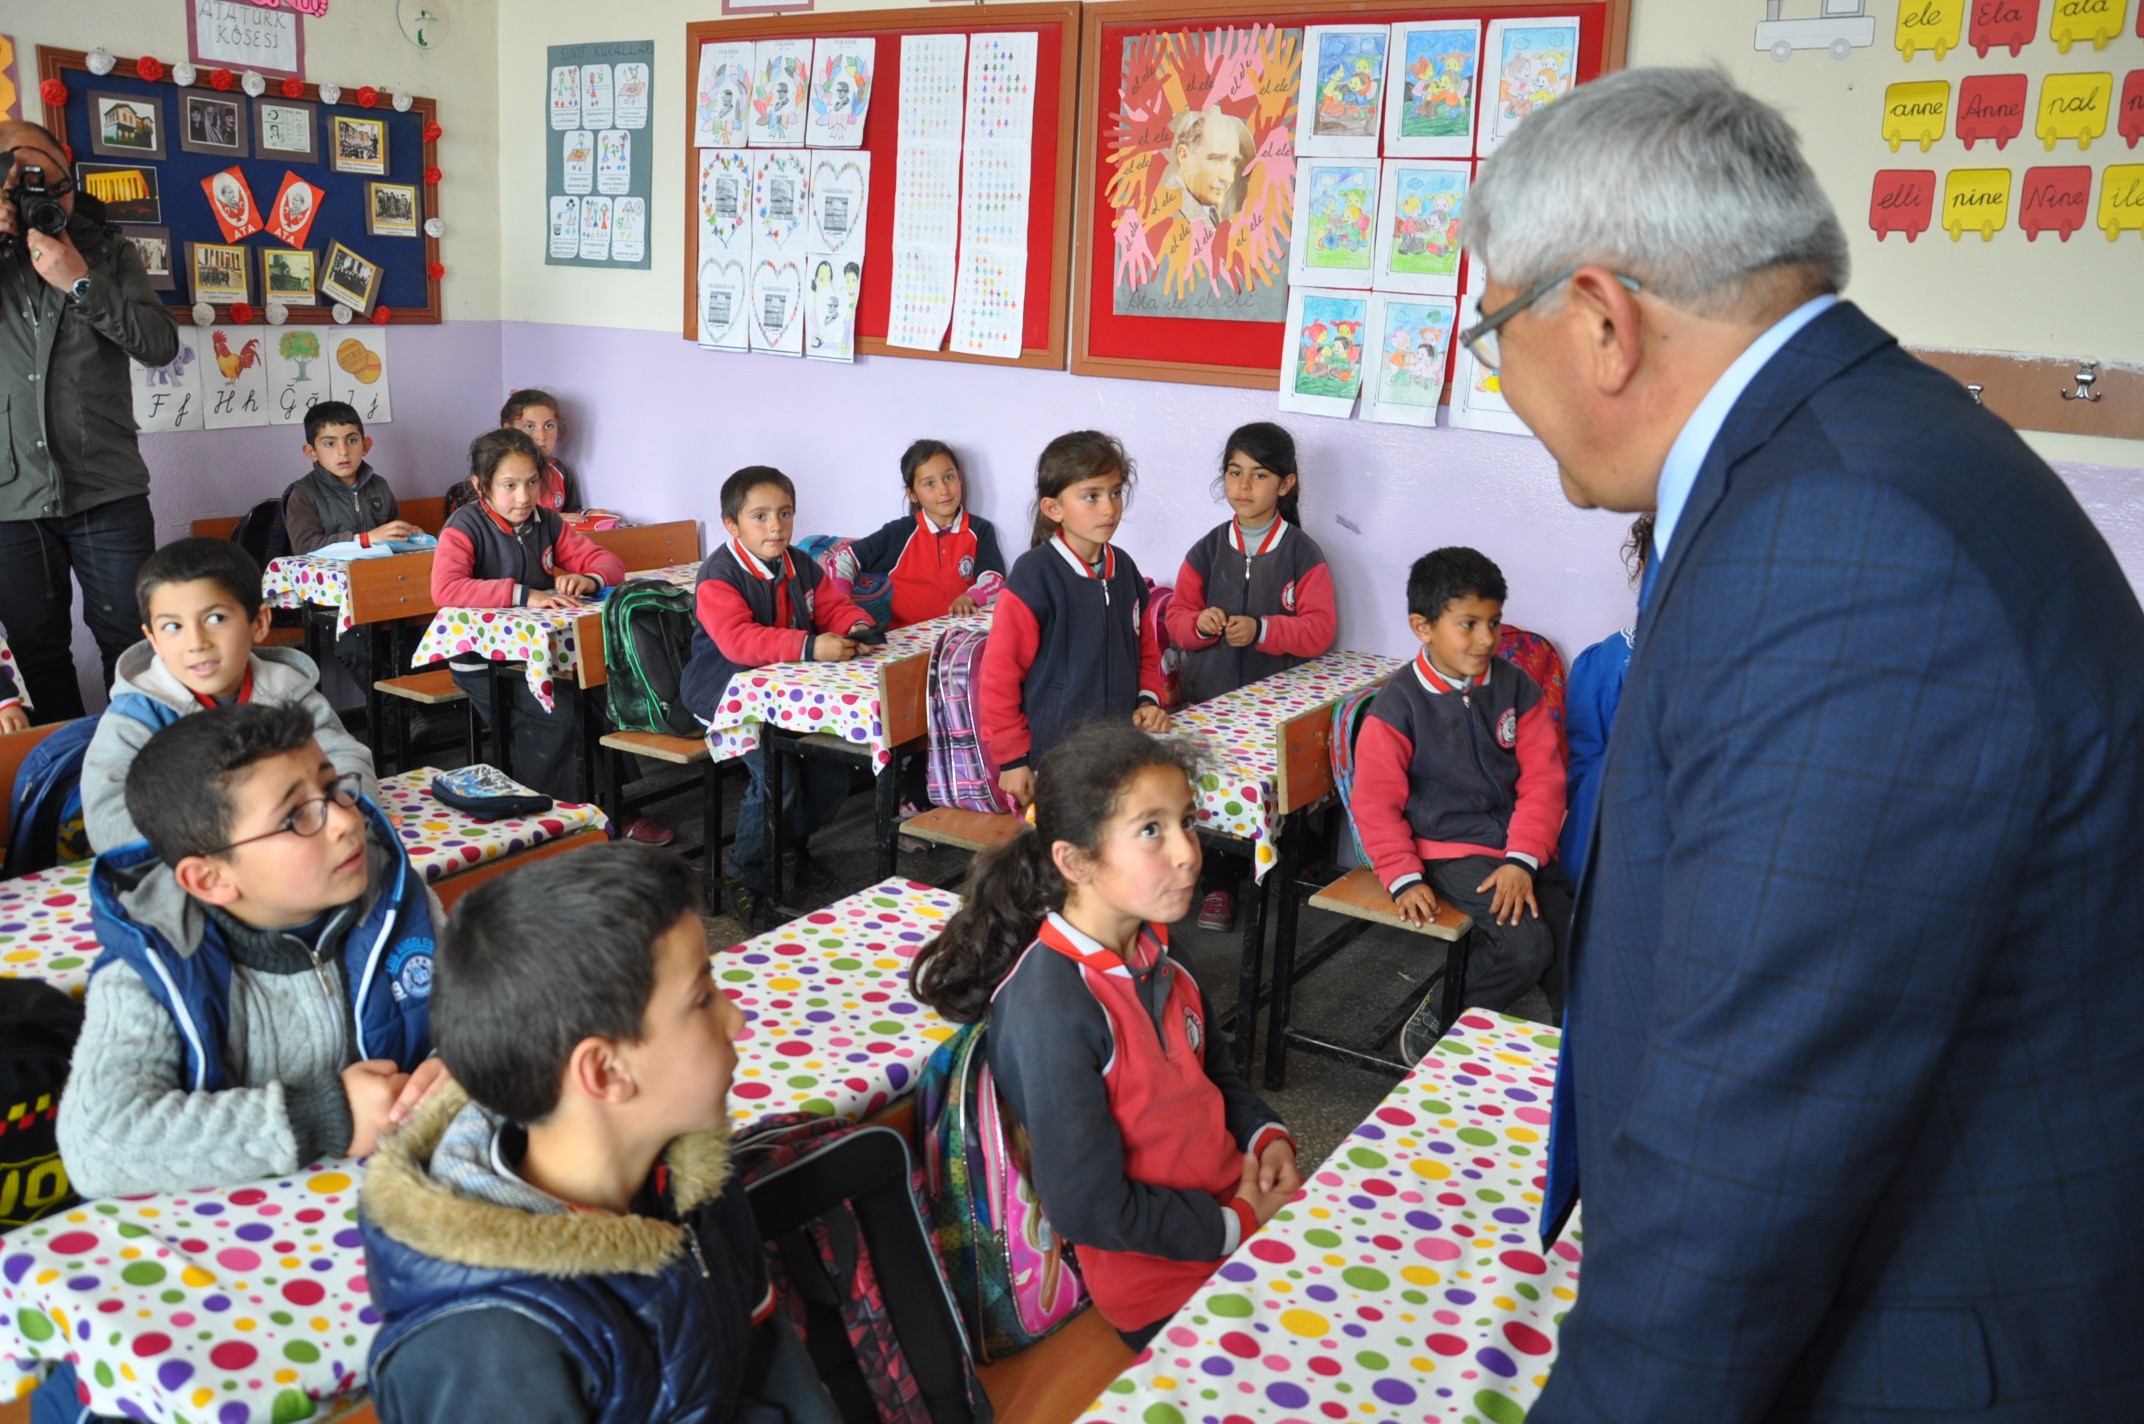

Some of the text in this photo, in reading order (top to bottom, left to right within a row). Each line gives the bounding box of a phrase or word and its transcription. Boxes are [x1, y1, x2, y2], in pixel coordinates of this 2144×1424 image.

[199, 0, 286, 29] ATATÜRK
[1902, 1, 1942, 28] ele
[1977, 3, 2022, 26] Ela
[1890, 101, 1943, 117] anne
[1961, 94, 2021, 119] Anne
[2048, 86, 2099, 114] nal
[1877, 183, 1921, 209] elli
[1952, 188, 2003, 208] nine
[2026, 184, 2084, 211] Nine
[2110, 179, 2144, 208] ile
[234, 224, 256, 239] ATA
[274, 228, 295, 245] ATA
[149, 393, 191, 427] F f
[214, 389, 259, 414] H h
